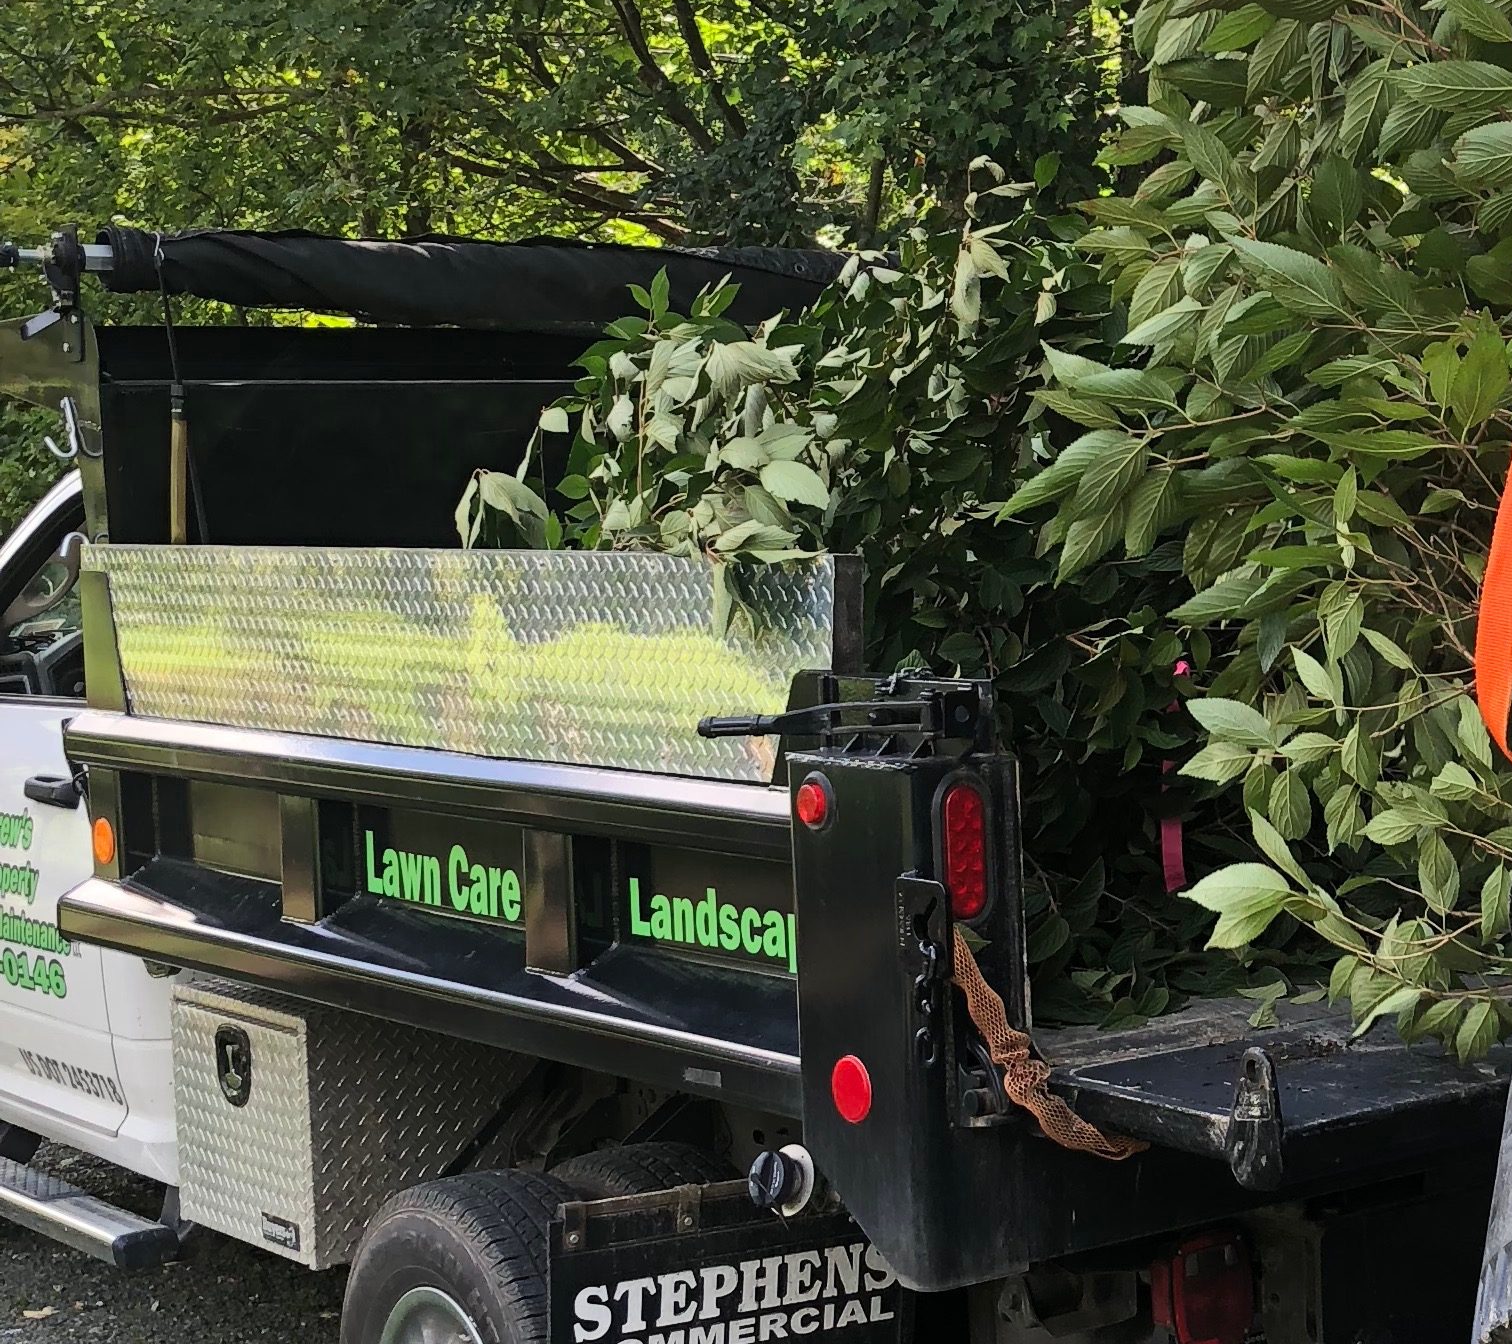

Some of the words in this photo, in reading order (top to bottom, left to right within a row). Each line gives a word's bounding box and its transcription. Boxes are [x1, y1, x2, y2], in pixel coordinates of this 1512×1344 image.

[0, 860, 40, 905] perty
[365, 830, 441, 906] Lawn
[448, 844, 522, 922] Care
[18, 1047, 43, 1078] US
[35, 1053, 67, 1086] DOT
[61, 1062, 124, 1106] 2453718
[572, 1243, 897, 1344] STEPHENS
